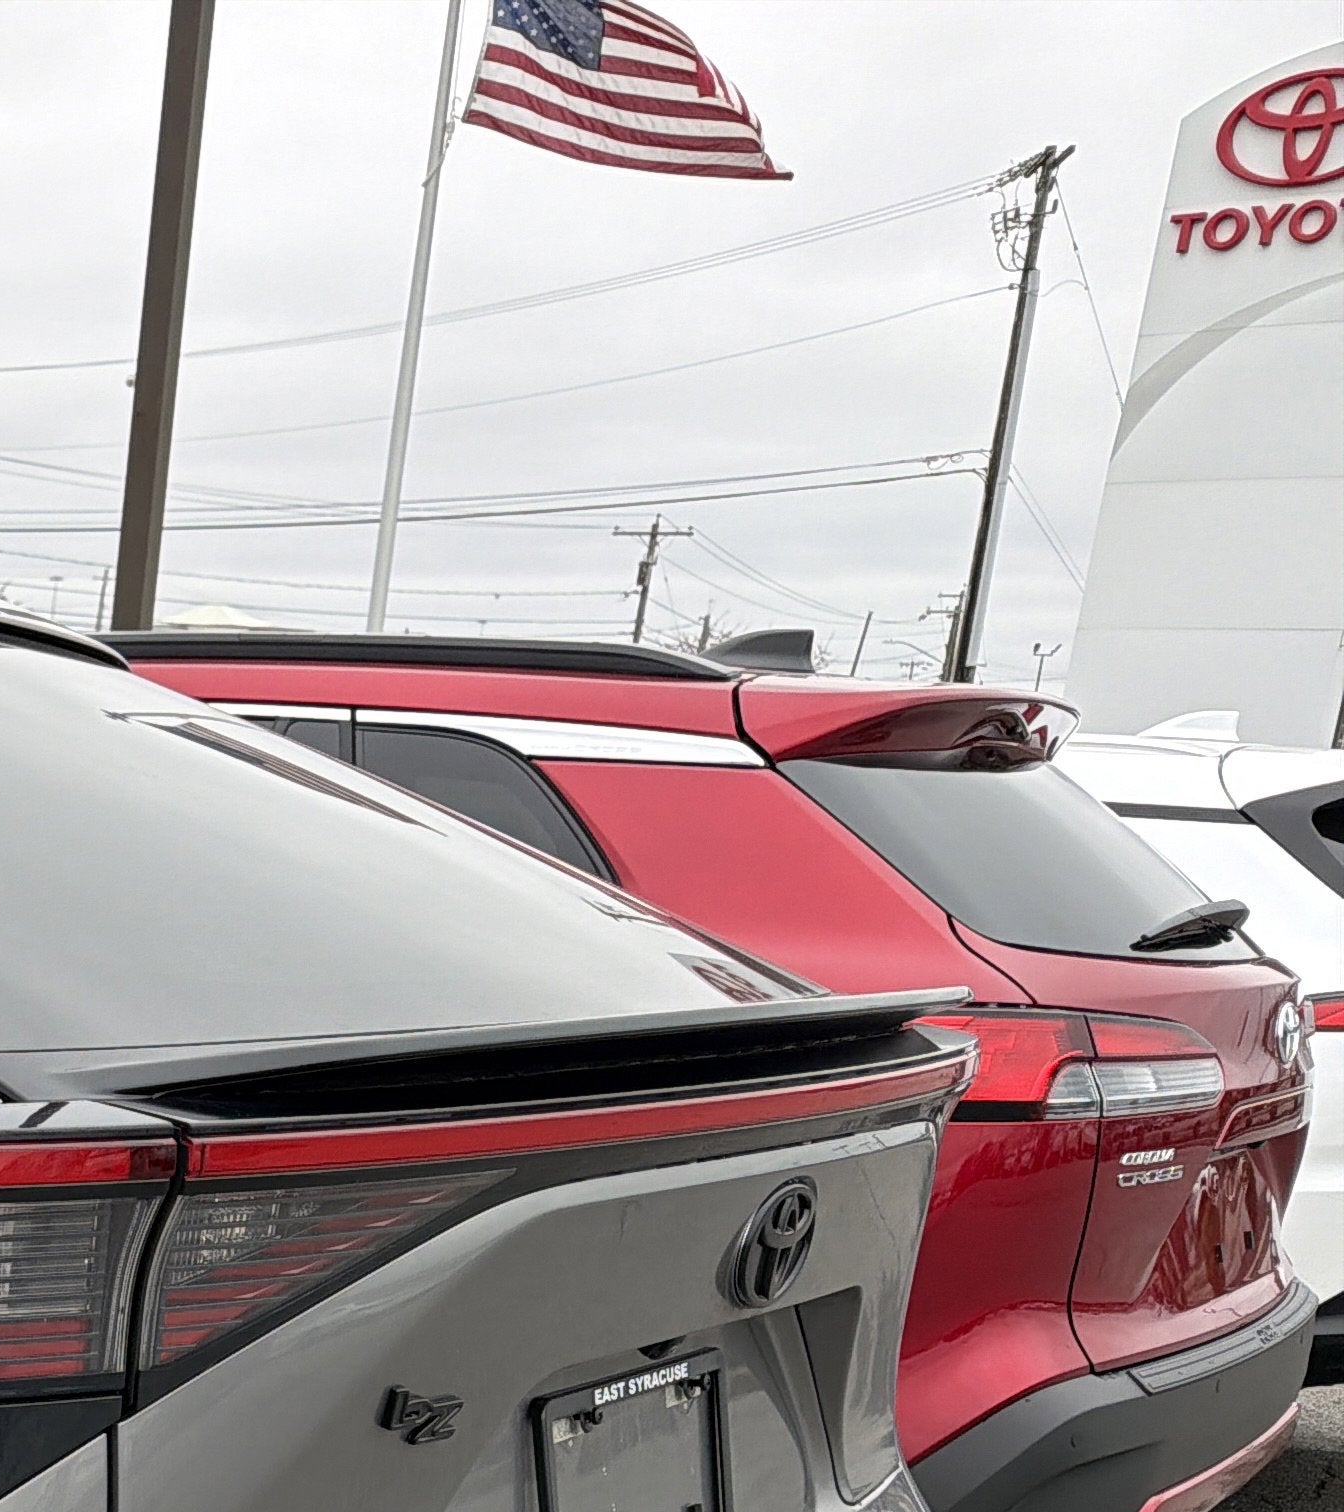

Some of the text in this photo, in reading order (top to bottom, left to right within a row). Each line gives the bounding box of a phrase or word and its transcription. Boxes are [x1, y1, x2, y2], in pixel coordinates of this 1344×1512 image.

[1170, 198, 1344, 254] TOYO
[594, 1361, 689, 1406] EAST SYRACUSE
